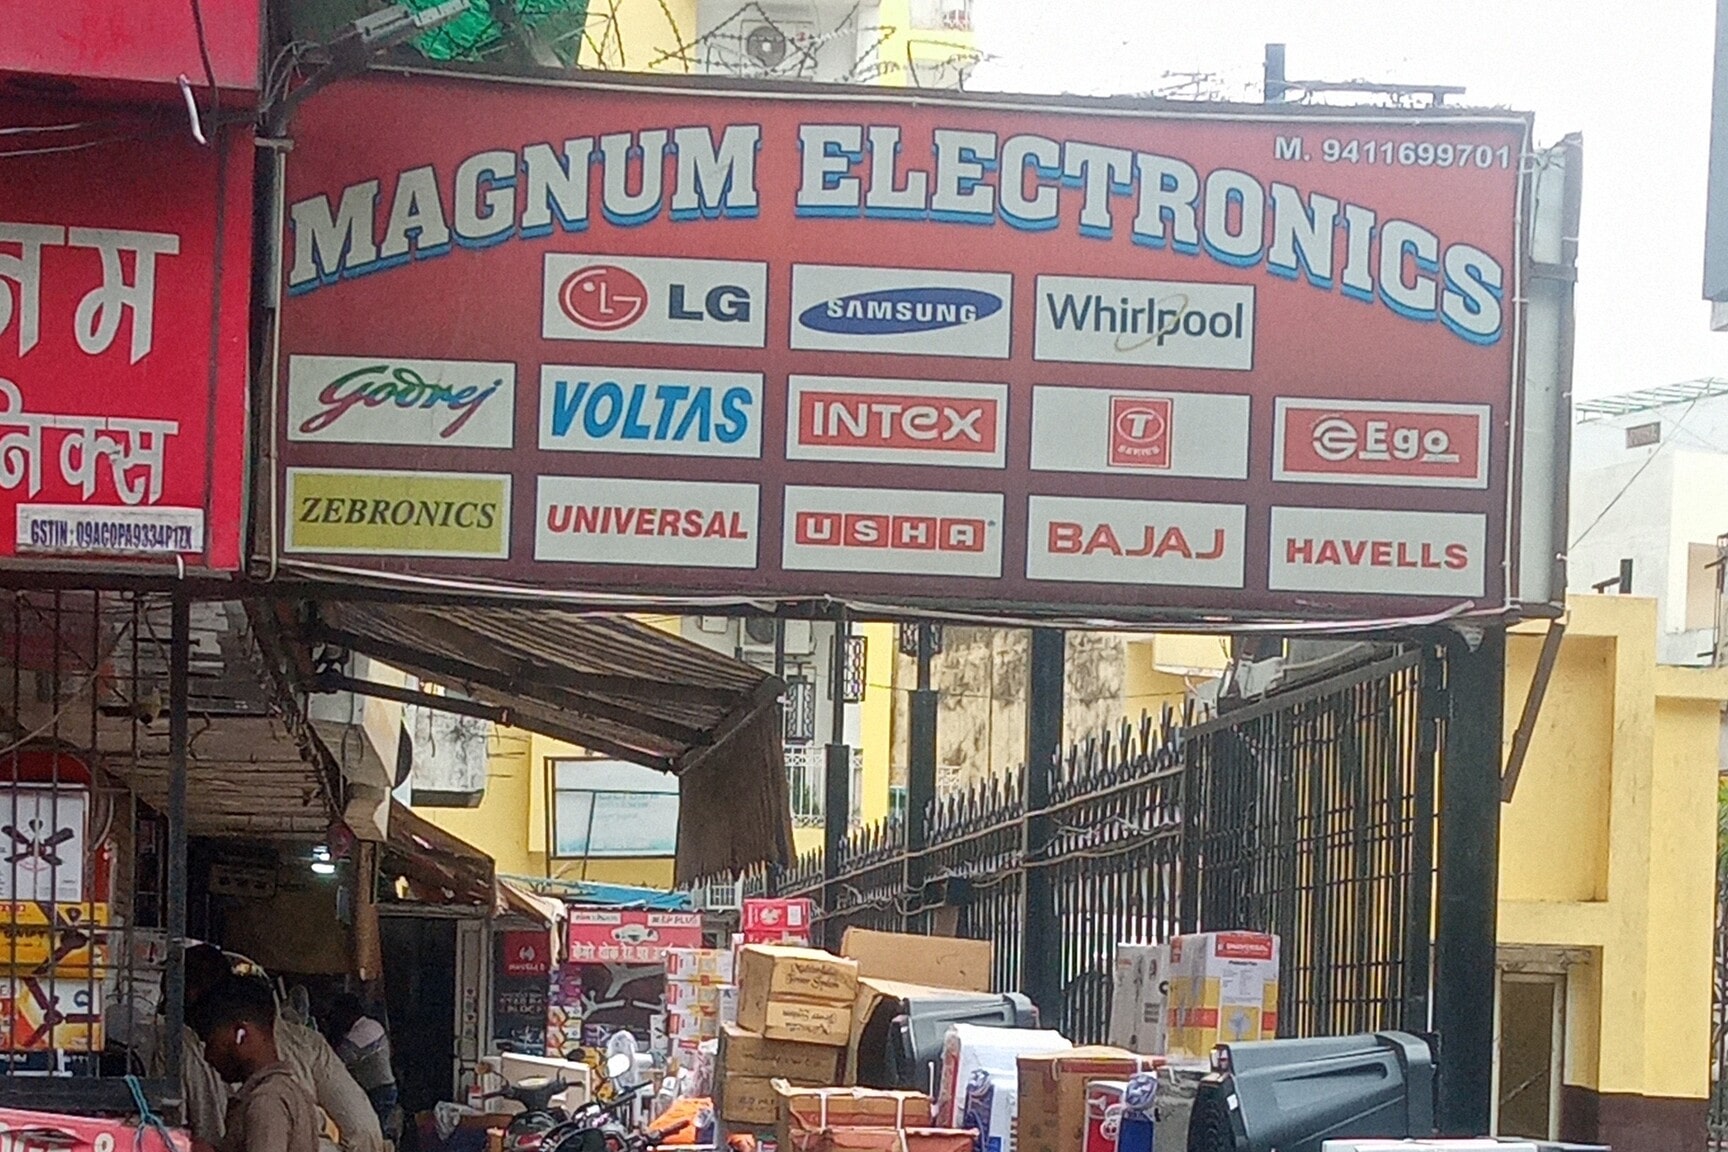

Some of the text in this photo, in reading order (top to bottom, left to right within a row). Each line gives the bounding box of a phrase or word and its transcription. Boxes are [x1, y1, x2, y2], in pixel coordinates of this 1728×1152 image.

[1274, 136, 1511, 169] M. 9411699701
[289, 124, 1503, 345] MAGNUM ELECTRONICS
[668, 283, 751, 322] LG
[826, 299, 978, 323] SAMSUNG
[1046, 292, 1244, 346] Whirlpool
[551, 380, 753, 444] VOLTAS
[1116, 444, 1161, 457] SERIES
[1365, 419, 1450, 461] Ego
[299, 496, 497, 530] ZEBRONICS
[546, 504, 749, 540] UNIVERSAL
[800, 514, 980, 549] USHA
[1047, 521, 1225, 560] BAJAJ
[1285, 538, 1469, 570] HAVELLS
